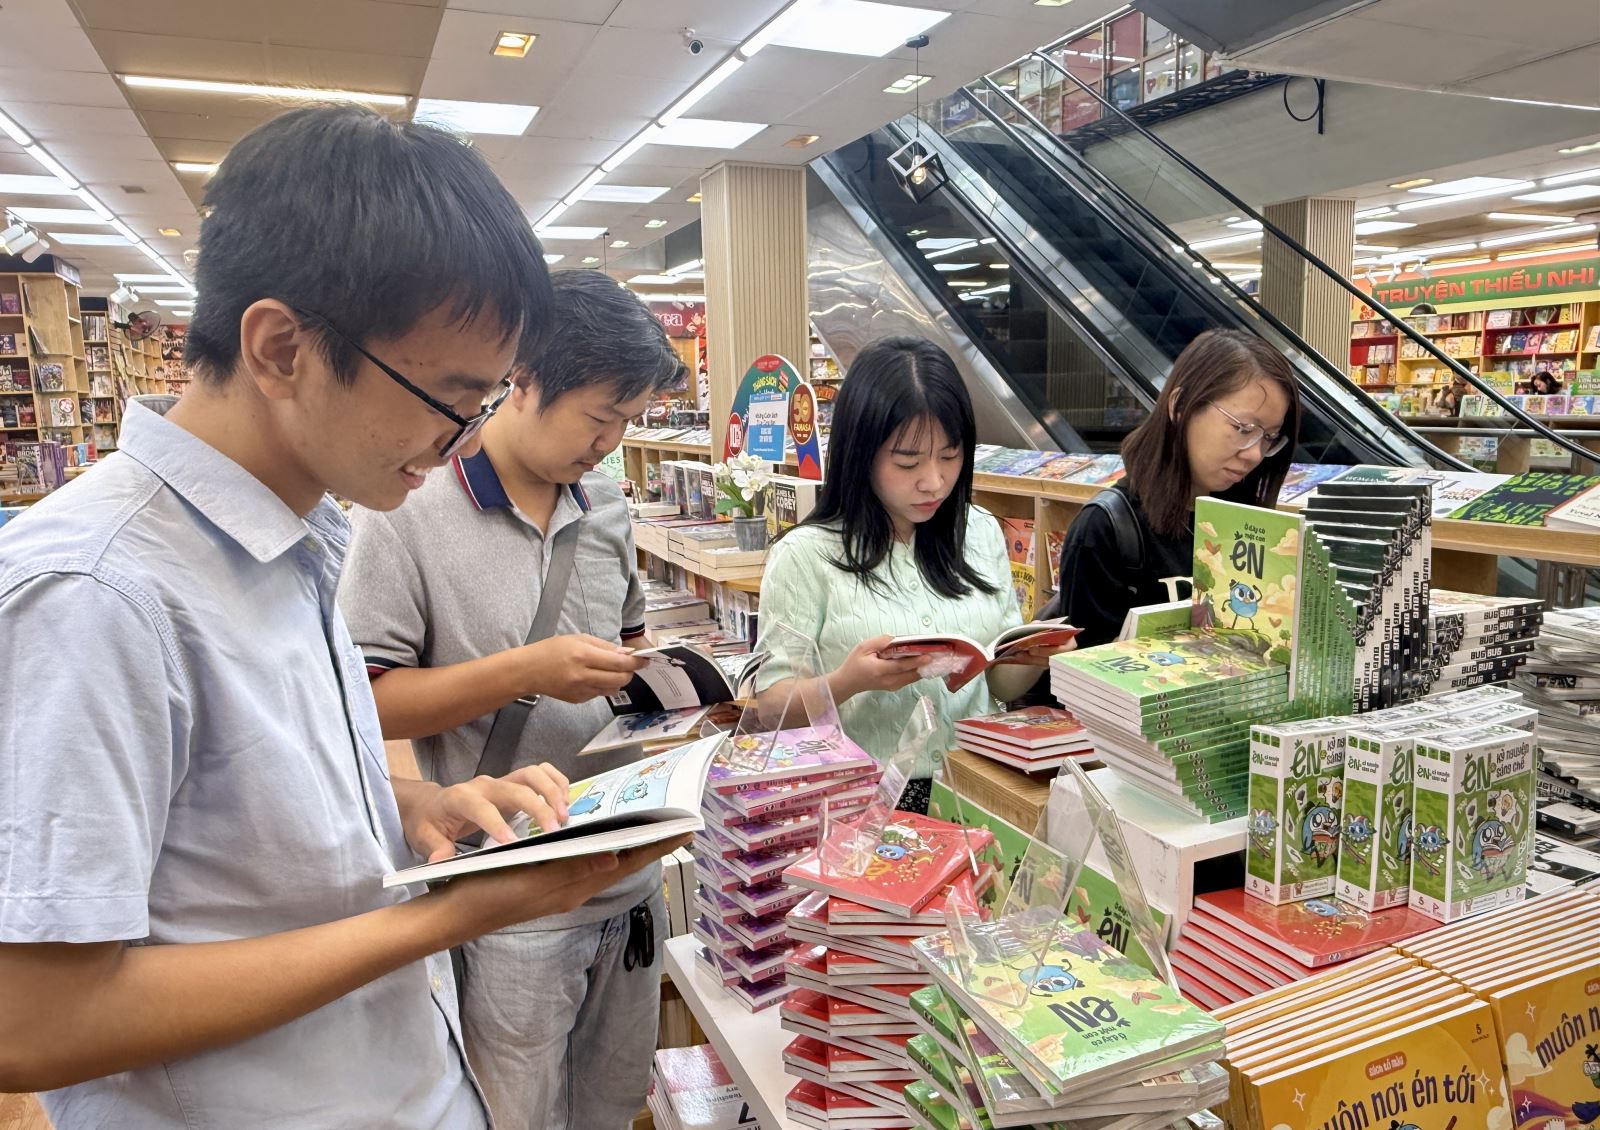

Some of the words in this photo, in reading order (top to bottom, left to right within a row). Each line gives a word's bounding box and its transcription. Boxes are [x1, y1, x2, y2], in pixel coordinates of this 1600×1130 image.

[1377, 279, 1466, 305] TRUYỆN
[1470, 268, 1543, 296] THIẾU
[1547, 267, 1595, 287] NHI
[1483, 610, 1499, 620] BUG
[1483, 623, 1498, 633] BUG
[1479, 636, 1494, 645] BUG
[1470, 650, 1486, 660] BUG
[1461, 665, 1477, 674] BUG
[1451, 678, 1467, 688] BUG
[1535, 1012, 1587, 1069] muôn
[1319, 1099, 1375, 1130] uôn
[1371, 1079, 1408, 1123] nơi
[1411, 1069, 1438, 1108] én
[1443, 1065, 1476, 1105] tới
